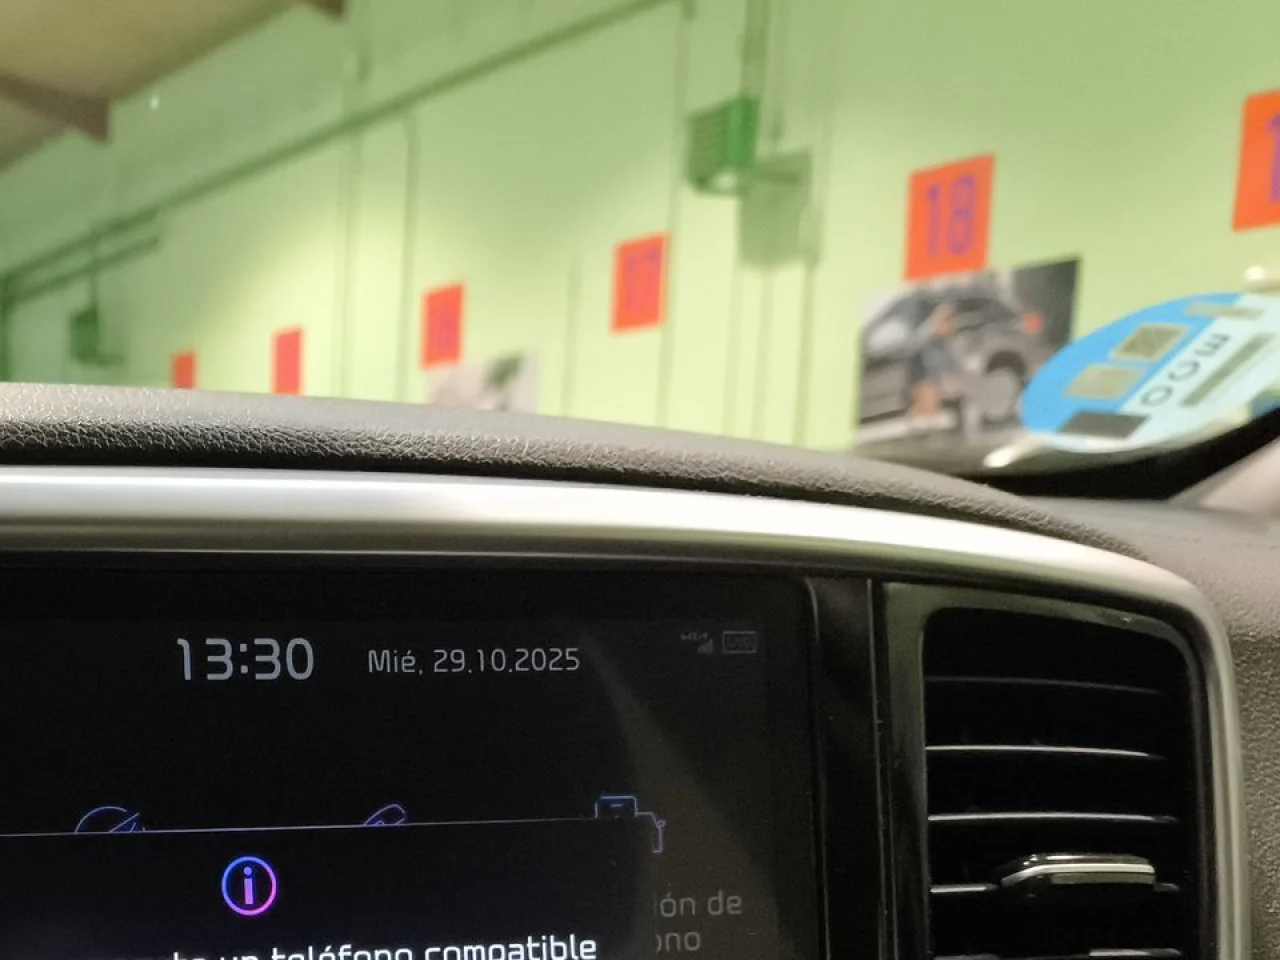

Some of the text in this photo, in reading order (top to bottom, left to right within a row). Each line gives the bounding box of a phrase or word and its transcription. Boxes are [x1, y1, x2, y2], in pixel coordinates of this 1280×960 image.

[925, 173, 979, 258] 18
[176, 637, 315, 682] 13:30
[368, 647, 581, 676] Mié, 29.10.2025
[707, 889, 742, 915] de
